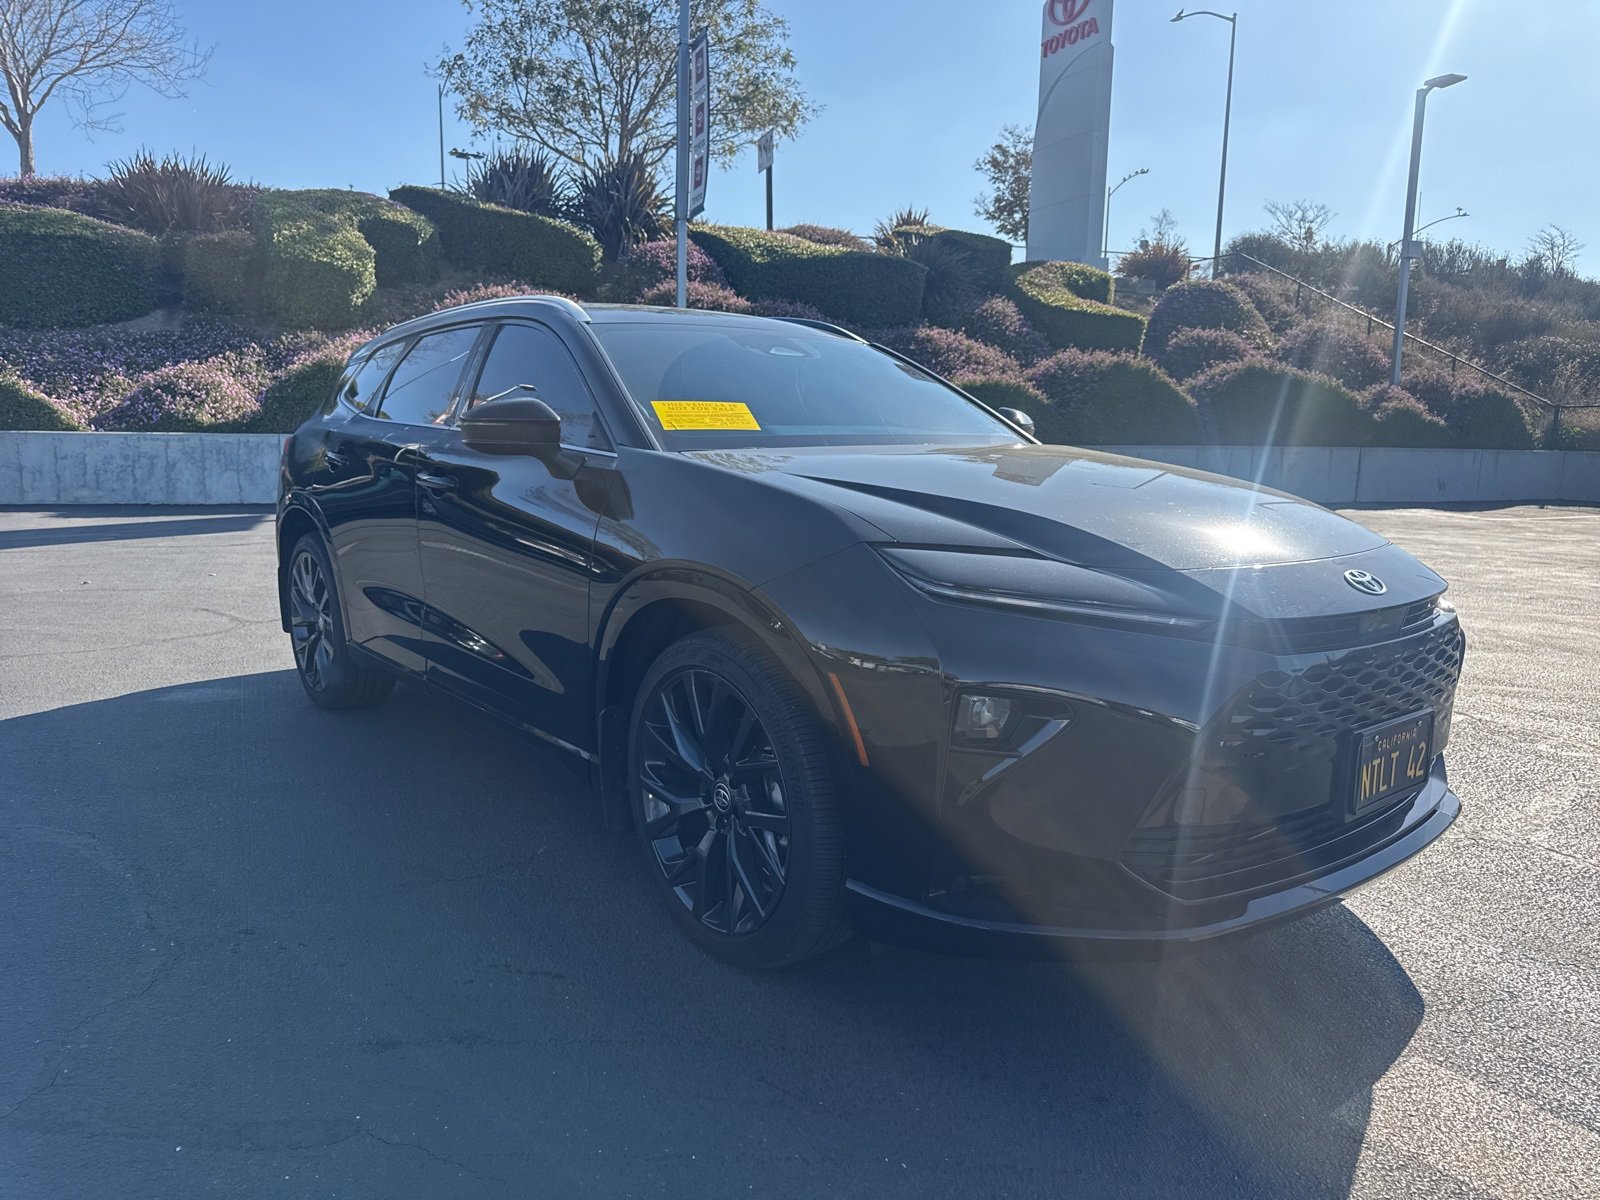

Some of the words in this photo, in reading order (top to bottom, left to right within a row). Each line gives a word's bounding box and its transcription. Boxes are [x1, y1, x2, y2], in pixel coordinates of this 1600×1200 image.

[1041, 17, 1099, 58] TOYOTA
[1377, 728, 1417, 751] CALIFORNIA
[1406, 741, 1426, 779] 42
